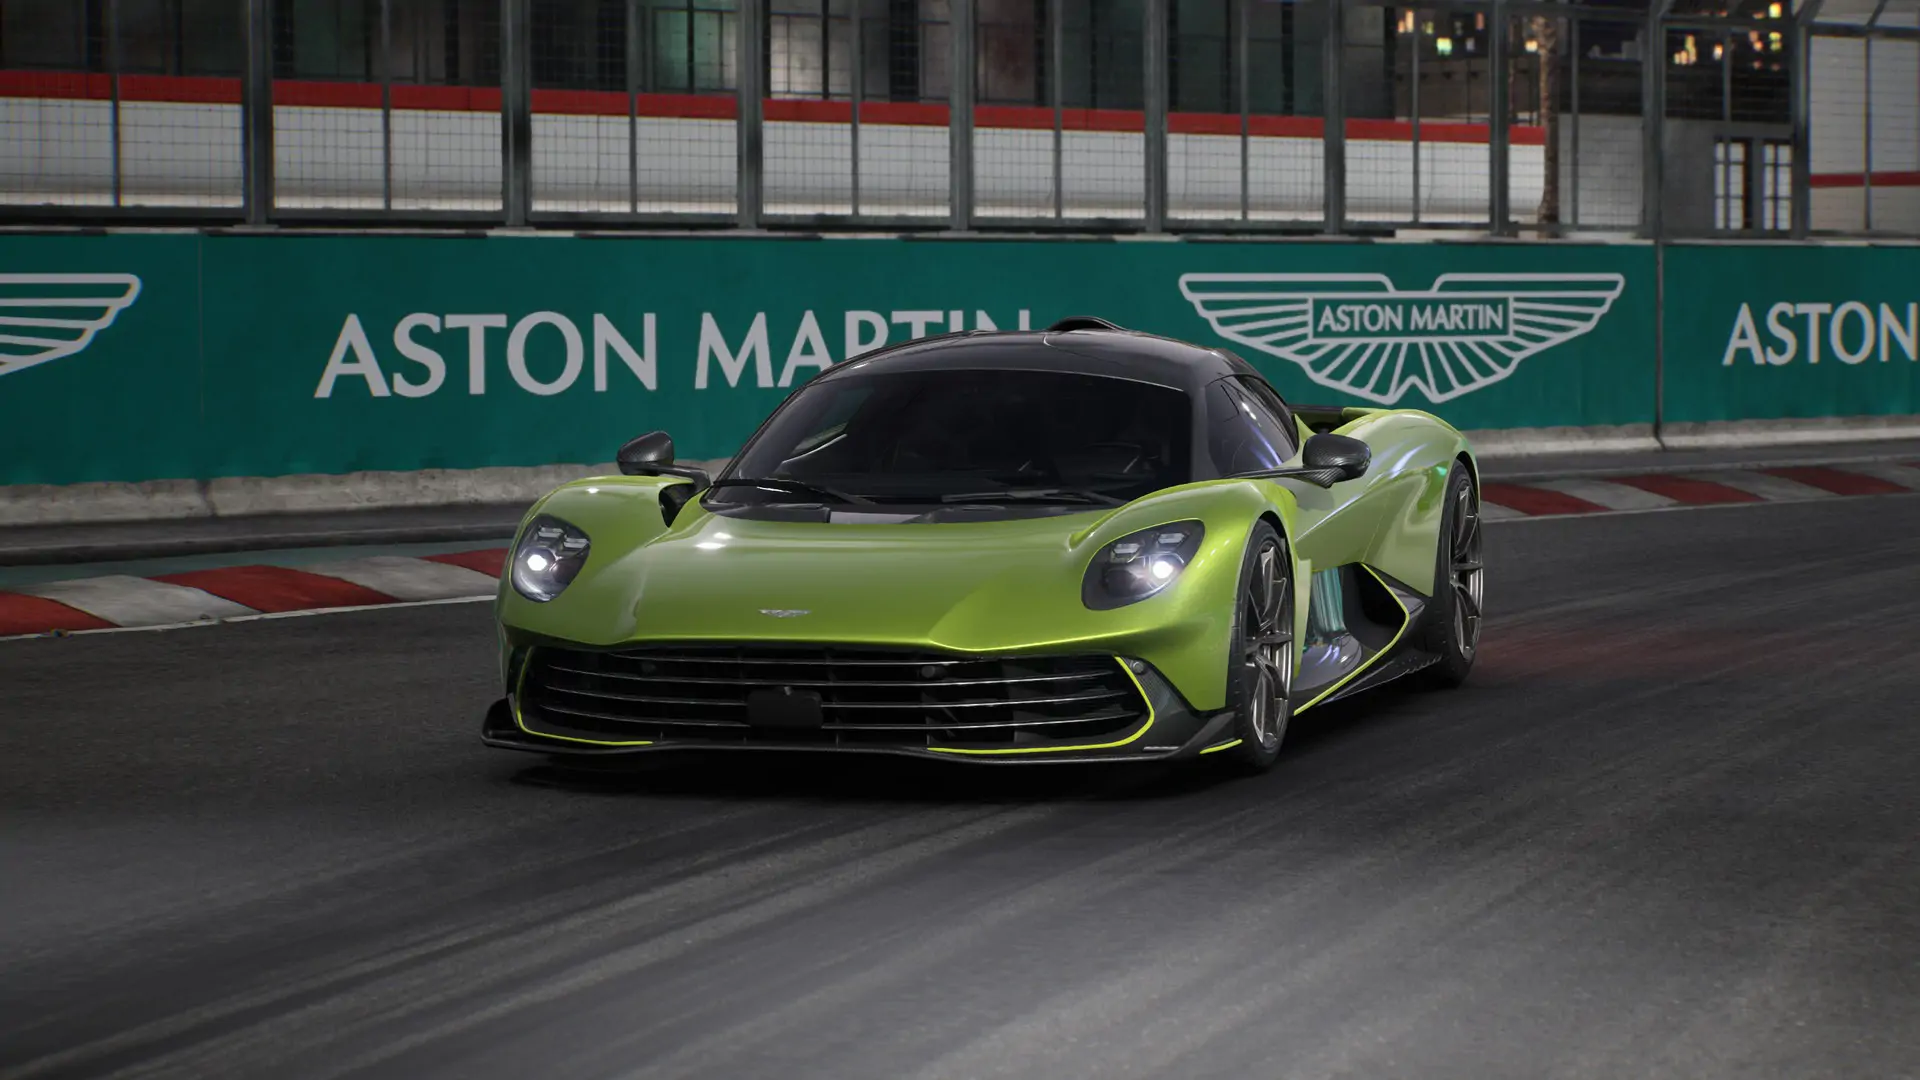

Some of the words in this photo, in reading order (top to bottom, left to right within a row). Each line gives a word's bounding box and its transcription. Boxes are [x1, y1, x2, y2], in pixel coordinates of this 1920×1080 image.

[1317, 303, 1403, 332] ASTON
[1410, 303, 1503, 331] MARTIN
[1722, 302, 1919, 366] ASTON
[314, 310, 657, 398] ASTON
[694, 309, 1031, 390] MART
